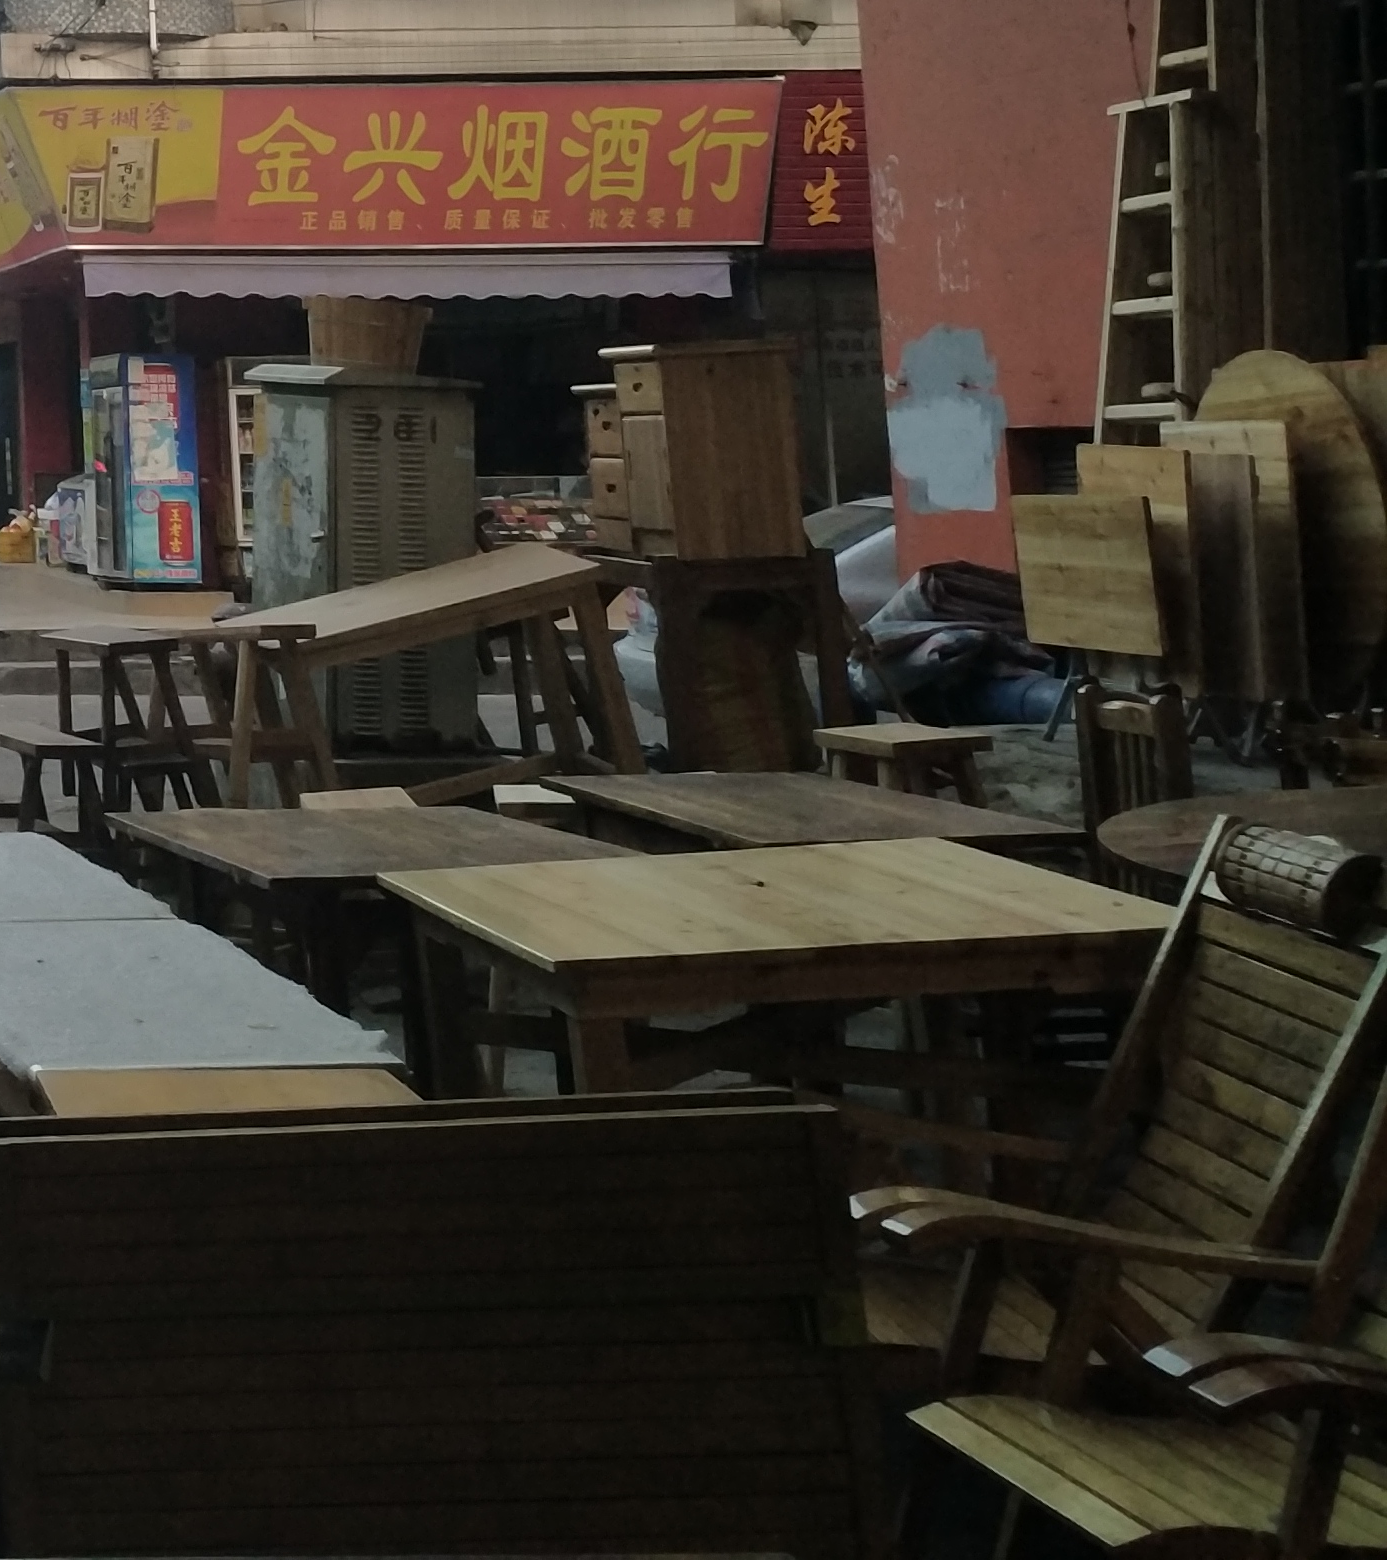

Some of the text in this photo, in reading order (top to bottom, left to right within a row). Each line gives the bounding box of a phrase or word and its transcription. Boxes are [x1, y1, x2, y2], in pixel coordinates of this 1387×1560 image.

[237, 104, 769, 207] 金兴烟酒行
[802, 98, 856, 227] 陈生
[169, 508, 183, 553] 王老吉
